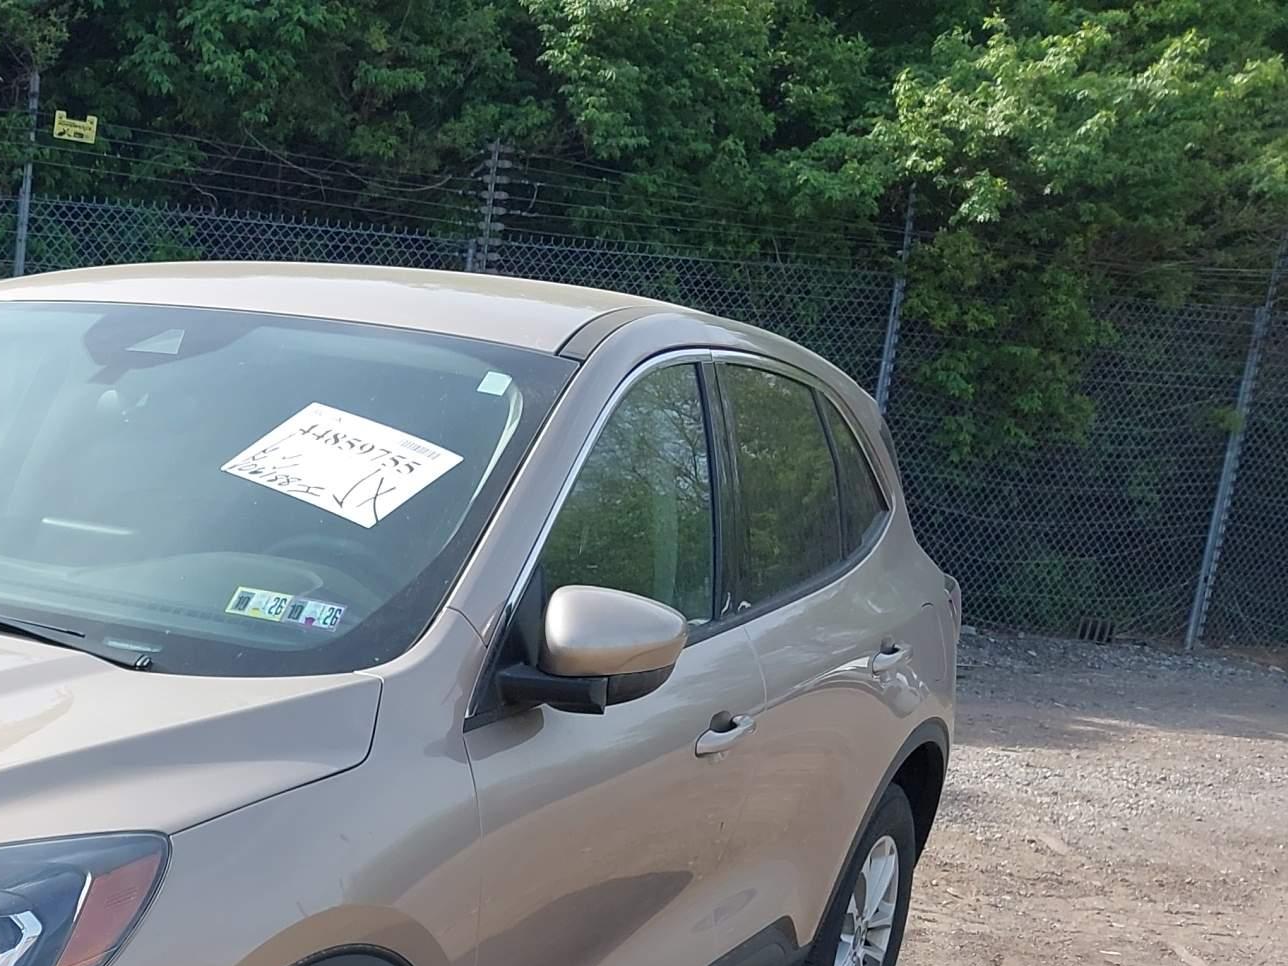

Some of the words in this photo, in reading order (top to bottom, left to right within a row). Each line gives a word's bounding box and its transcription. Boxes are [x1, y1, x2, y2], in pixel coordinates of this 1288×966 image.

[299, 424, 421, 475] 44859755
[268, 596, 288, 616] 26
[322, 607, 342, 626] 26
